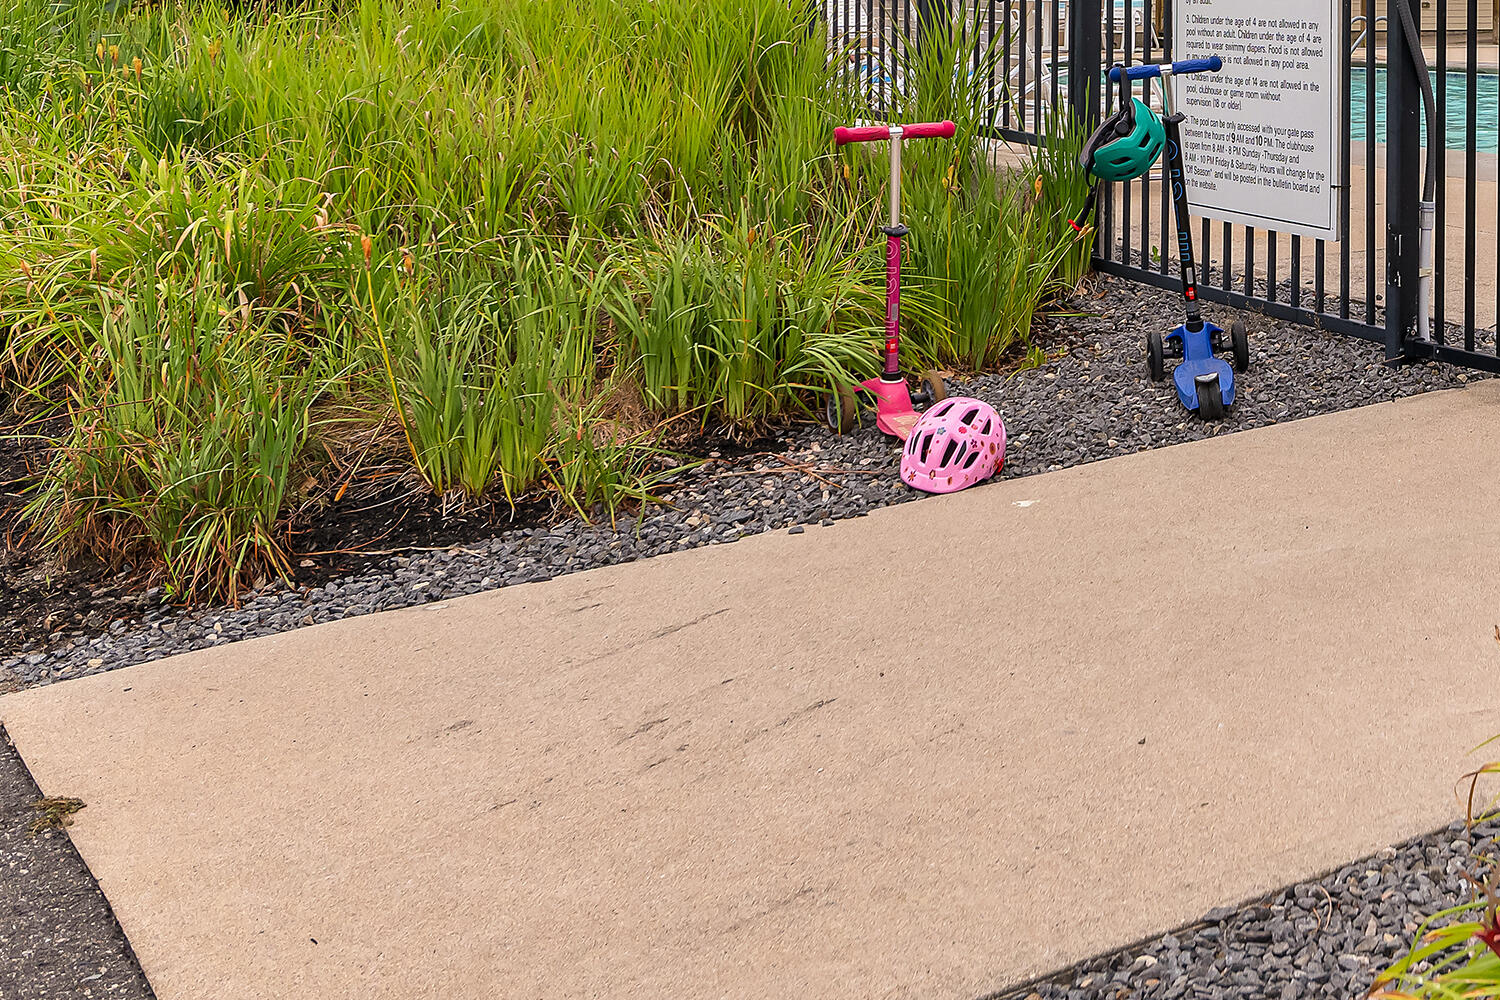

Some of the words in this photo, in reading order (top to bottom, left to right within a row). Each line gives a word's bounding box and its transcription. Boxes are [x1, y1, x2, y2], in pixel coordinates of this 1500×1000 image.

[1192, 14, 1210, 24] Children
[1210, 16, 1224, 24] under
[1225, 16, 1233, 25] the
[1235, 18, 1244, 27] age
[1268, 18, 1277, 27] not
[1279, 19, 1300, 28] allowed
[1308, 22, 1319, 31] any
[1186, 28, 1195, 38] pool
[1197, 28, 1215, 38] without
[1238, 30, 1258, 40] Children
[1259, 31, 1274, 41] under
[1276, 32, 1284, 41] the
[1286, 34, 1297, 44] age
[1186, 40, 1204, 50] required
[1247, 43, 1266, 54] diapers.
[1268, 45, 1282, 54] Food
[1290, 46, 1300, 55] not
[1301, 47, 1323, 57] allowed
[1233, 56, 1242, 64] not
[1243, 56, 1263, 66] allowed
[1271, 60, 1281, 69] any
[1282, 60, 1294, 70] pool
[1210, 74, 1224, 83] under
[1234, 78, 1244, 87] age
[1270, 79, 1279, 88] not
[1280, 80, 1302, 90] allowed
[1310, 82, 1320, 92] the
[1186, 85, 1198, 94] pool,
[1199, 86, 1222, 95] clubhouse
[1230, 90, 1244, 98] game
[1260, 92, 1281, 101] without
[1186, 98, 1212, 107] supervision
[1190, 116, 1199, 125] The
[1200, 118, 1210, 127] pool
[1226, 121, 1236, 131] only
[1237, 124, 1260, 132] accessed
[1262, 125, 1273, 134] with
[1274, 128, 1287, 136] your
[1287, 128, 1300, 138] gate
[1301, 131, 1314, 139] pass
[1185, 128, 1203, 138] between
[1212, 131, 1225, 141] hours
[1245, 136, 1255, 145] and
[1275, 139, 1286, 149] The
[1286, 141, 1314, 152] clubhouse
[1190, 142, 1201, 151] open
[1201, 142, 1211, 152] from
[1242, 148, 1261, 161] Sunday
[1289, 155, 1300, 164] and
[1215, 157, 1230, 169] Friday
[1260, 163, 1276, 174] Hours
[1276, 166, 1285, 175] will
[1286, 167, 1306, 180] change
[1316, 171, 1325, 181] the
[1214, 170, 1224, 179] and
[1240, 174, 1256, 184] posted
[1263, 177, 1272, 186] the
[1272, 178, 1291, 189] bulletin
[1292, 181, 1309, 192] board
[1309, 185, 1320, 194] and
